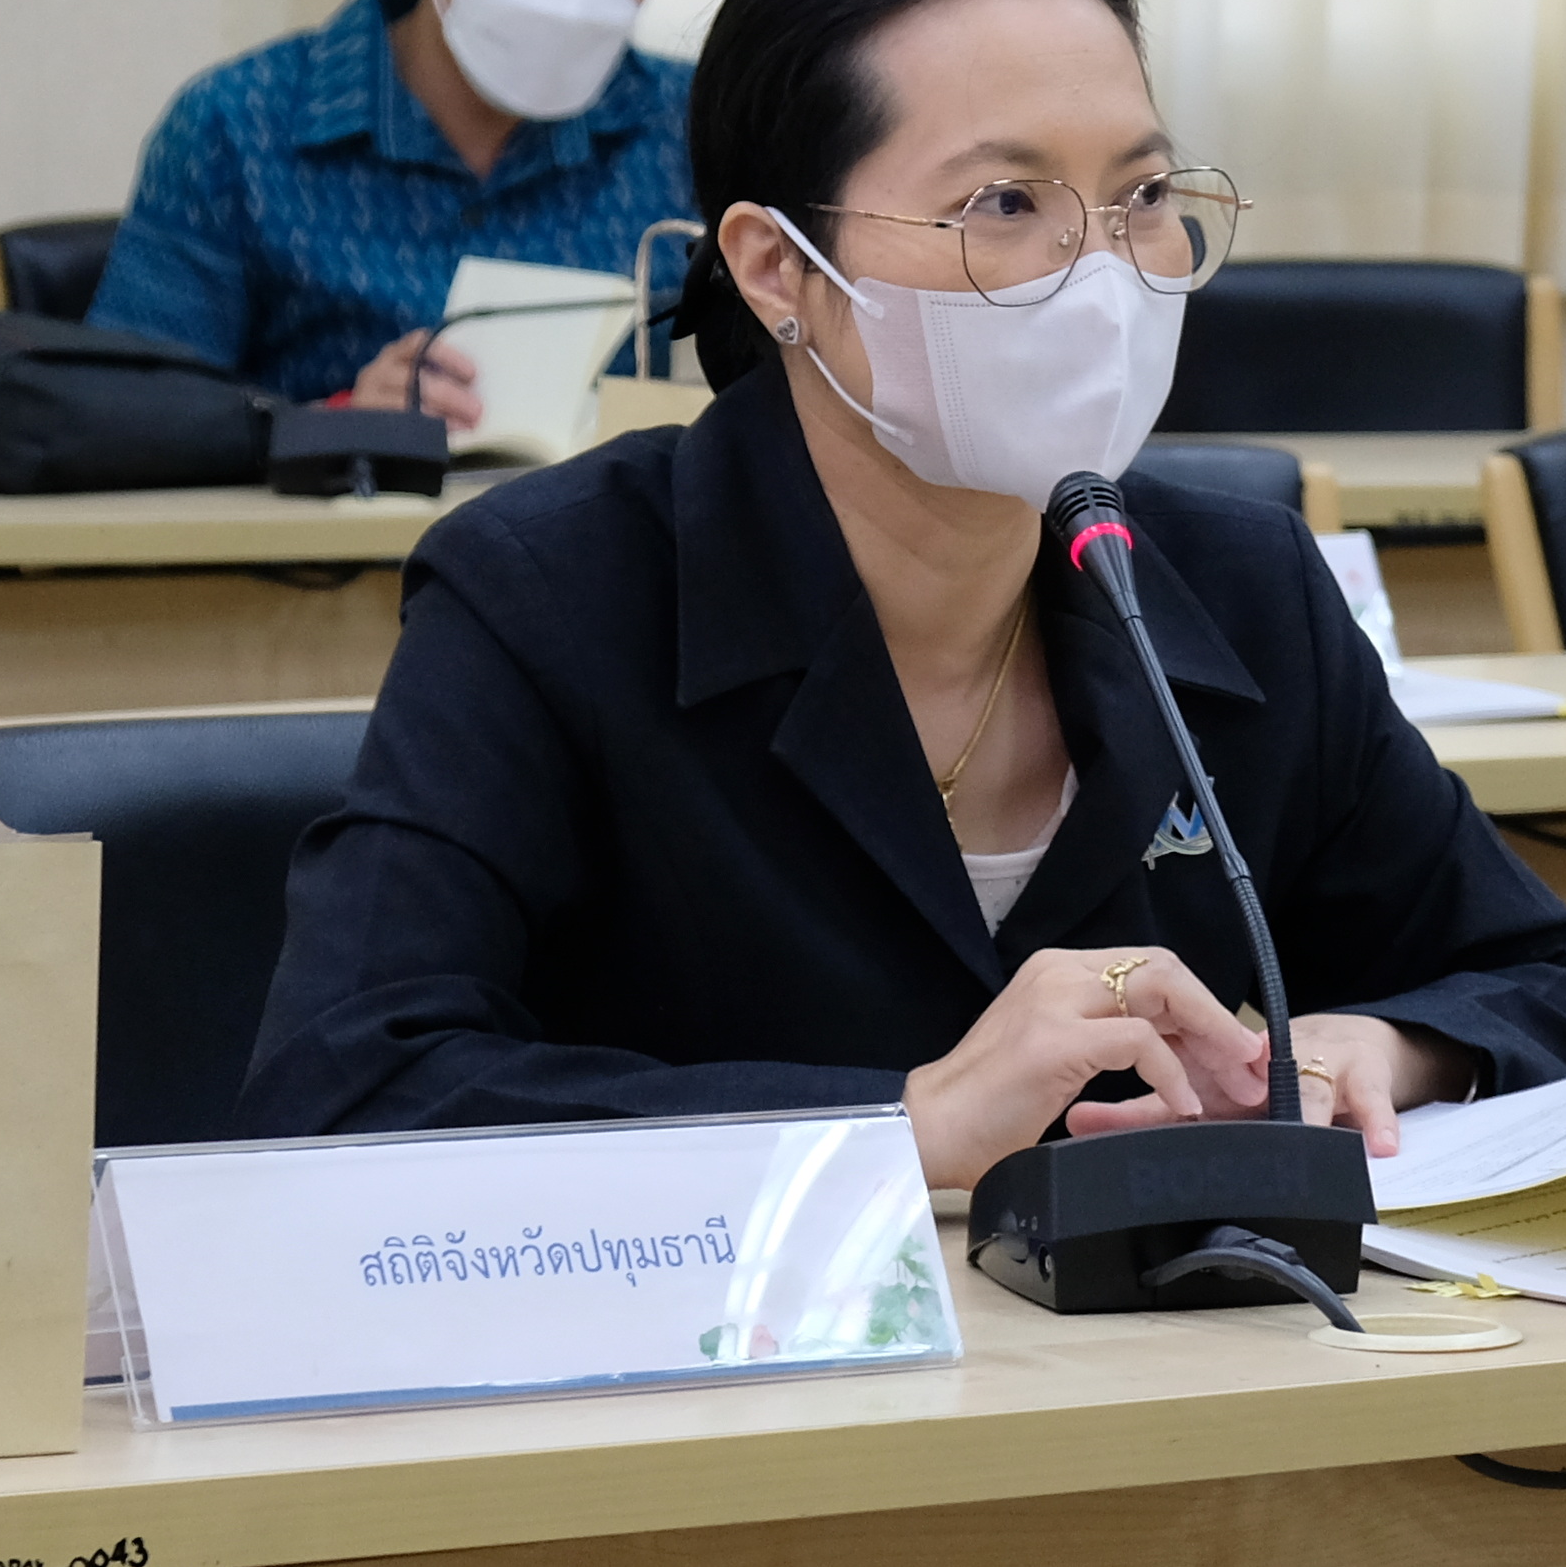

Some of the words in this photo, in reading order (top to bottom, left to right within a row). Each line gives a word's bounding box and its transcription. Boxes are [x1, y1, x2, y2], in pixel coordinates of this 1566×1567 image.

[359, 1214, 736, 1288] สถิติจังหวัดปทุมธานี
